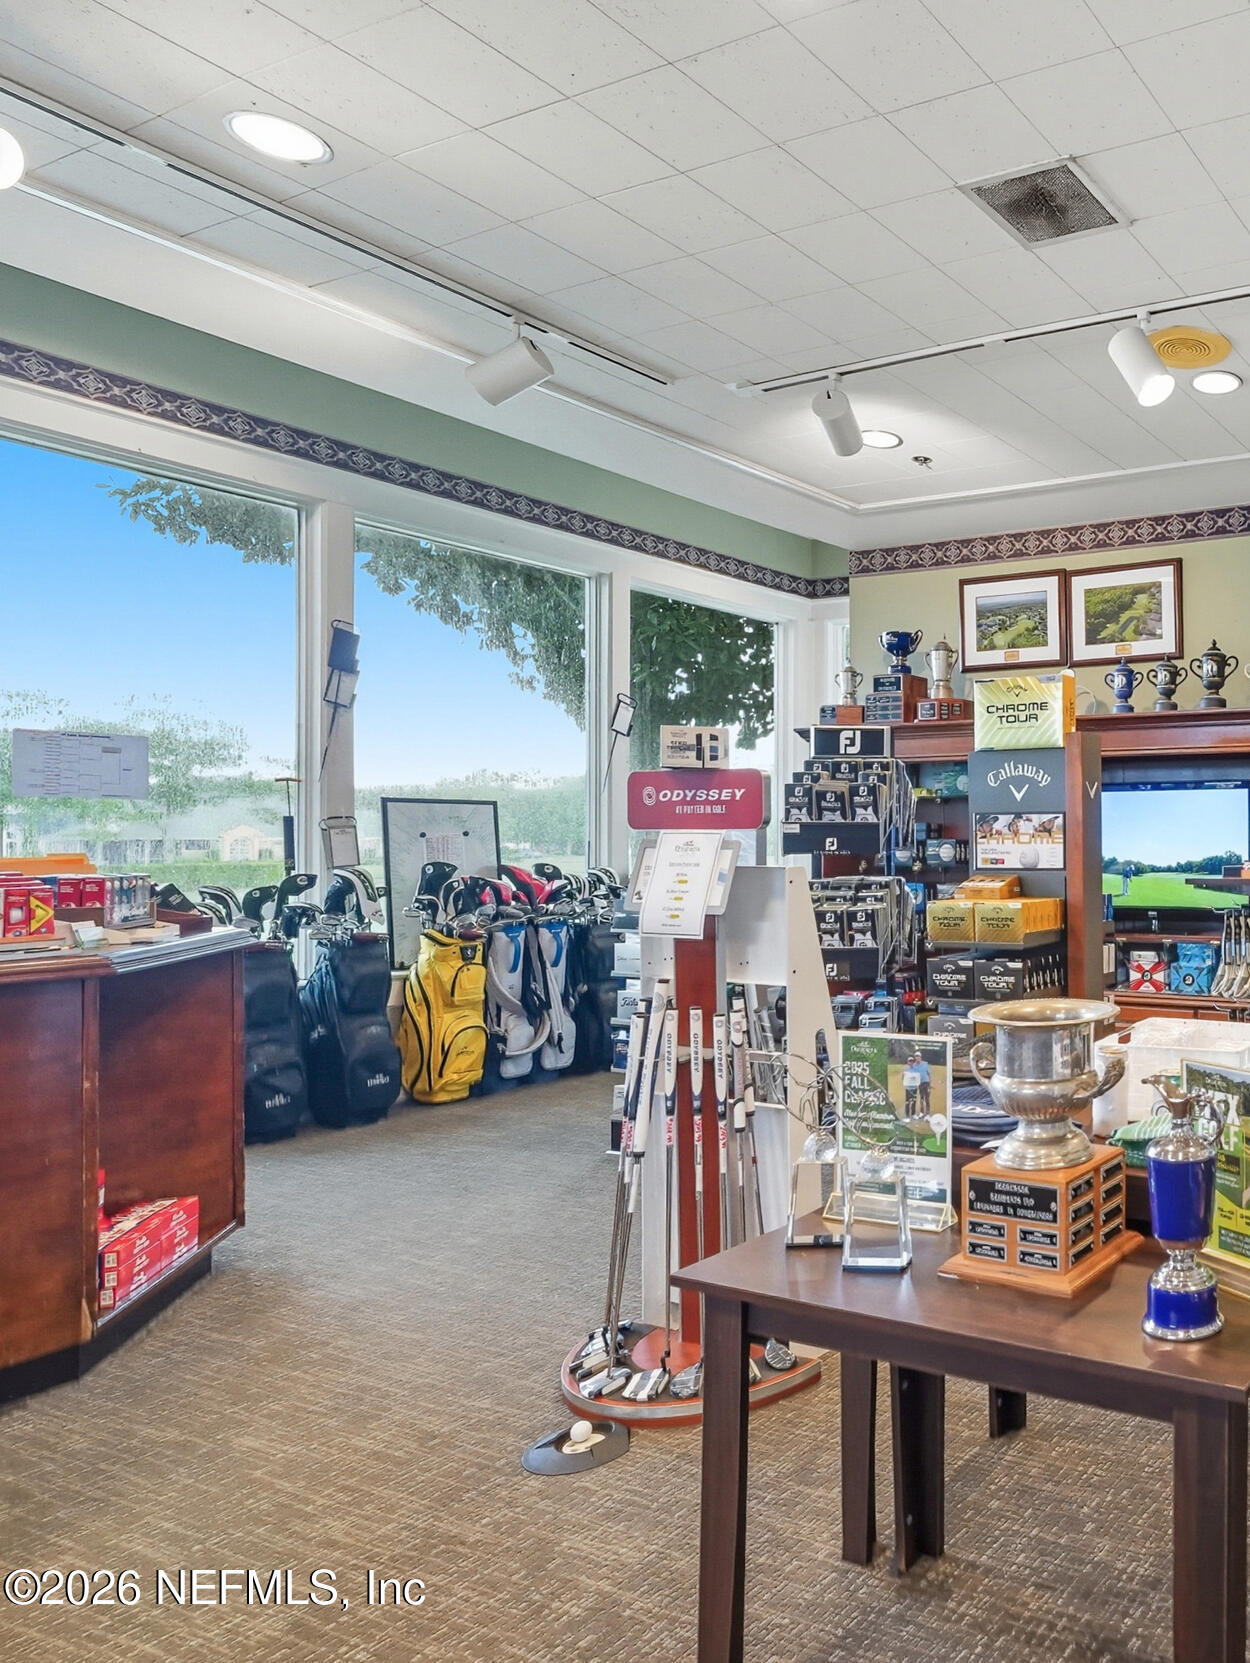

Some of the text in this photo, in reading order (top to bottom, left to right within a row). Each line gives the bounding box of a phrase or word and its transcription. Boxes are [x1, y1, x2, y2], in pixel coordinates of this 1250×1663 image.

[986, 701, 1049, 715] CHROME
[997, 714, 1039, 725] TOUR
[839, 730, 861, 755] FJ
[987, 760, 1051, 787] Callaway
[659, 789, 746, 801] ODYSSEY
[825, 837, 838, 851] FJ
[844, 1061, 870, 1075] 2025
[844, 1075, 870, 1090] FALL
